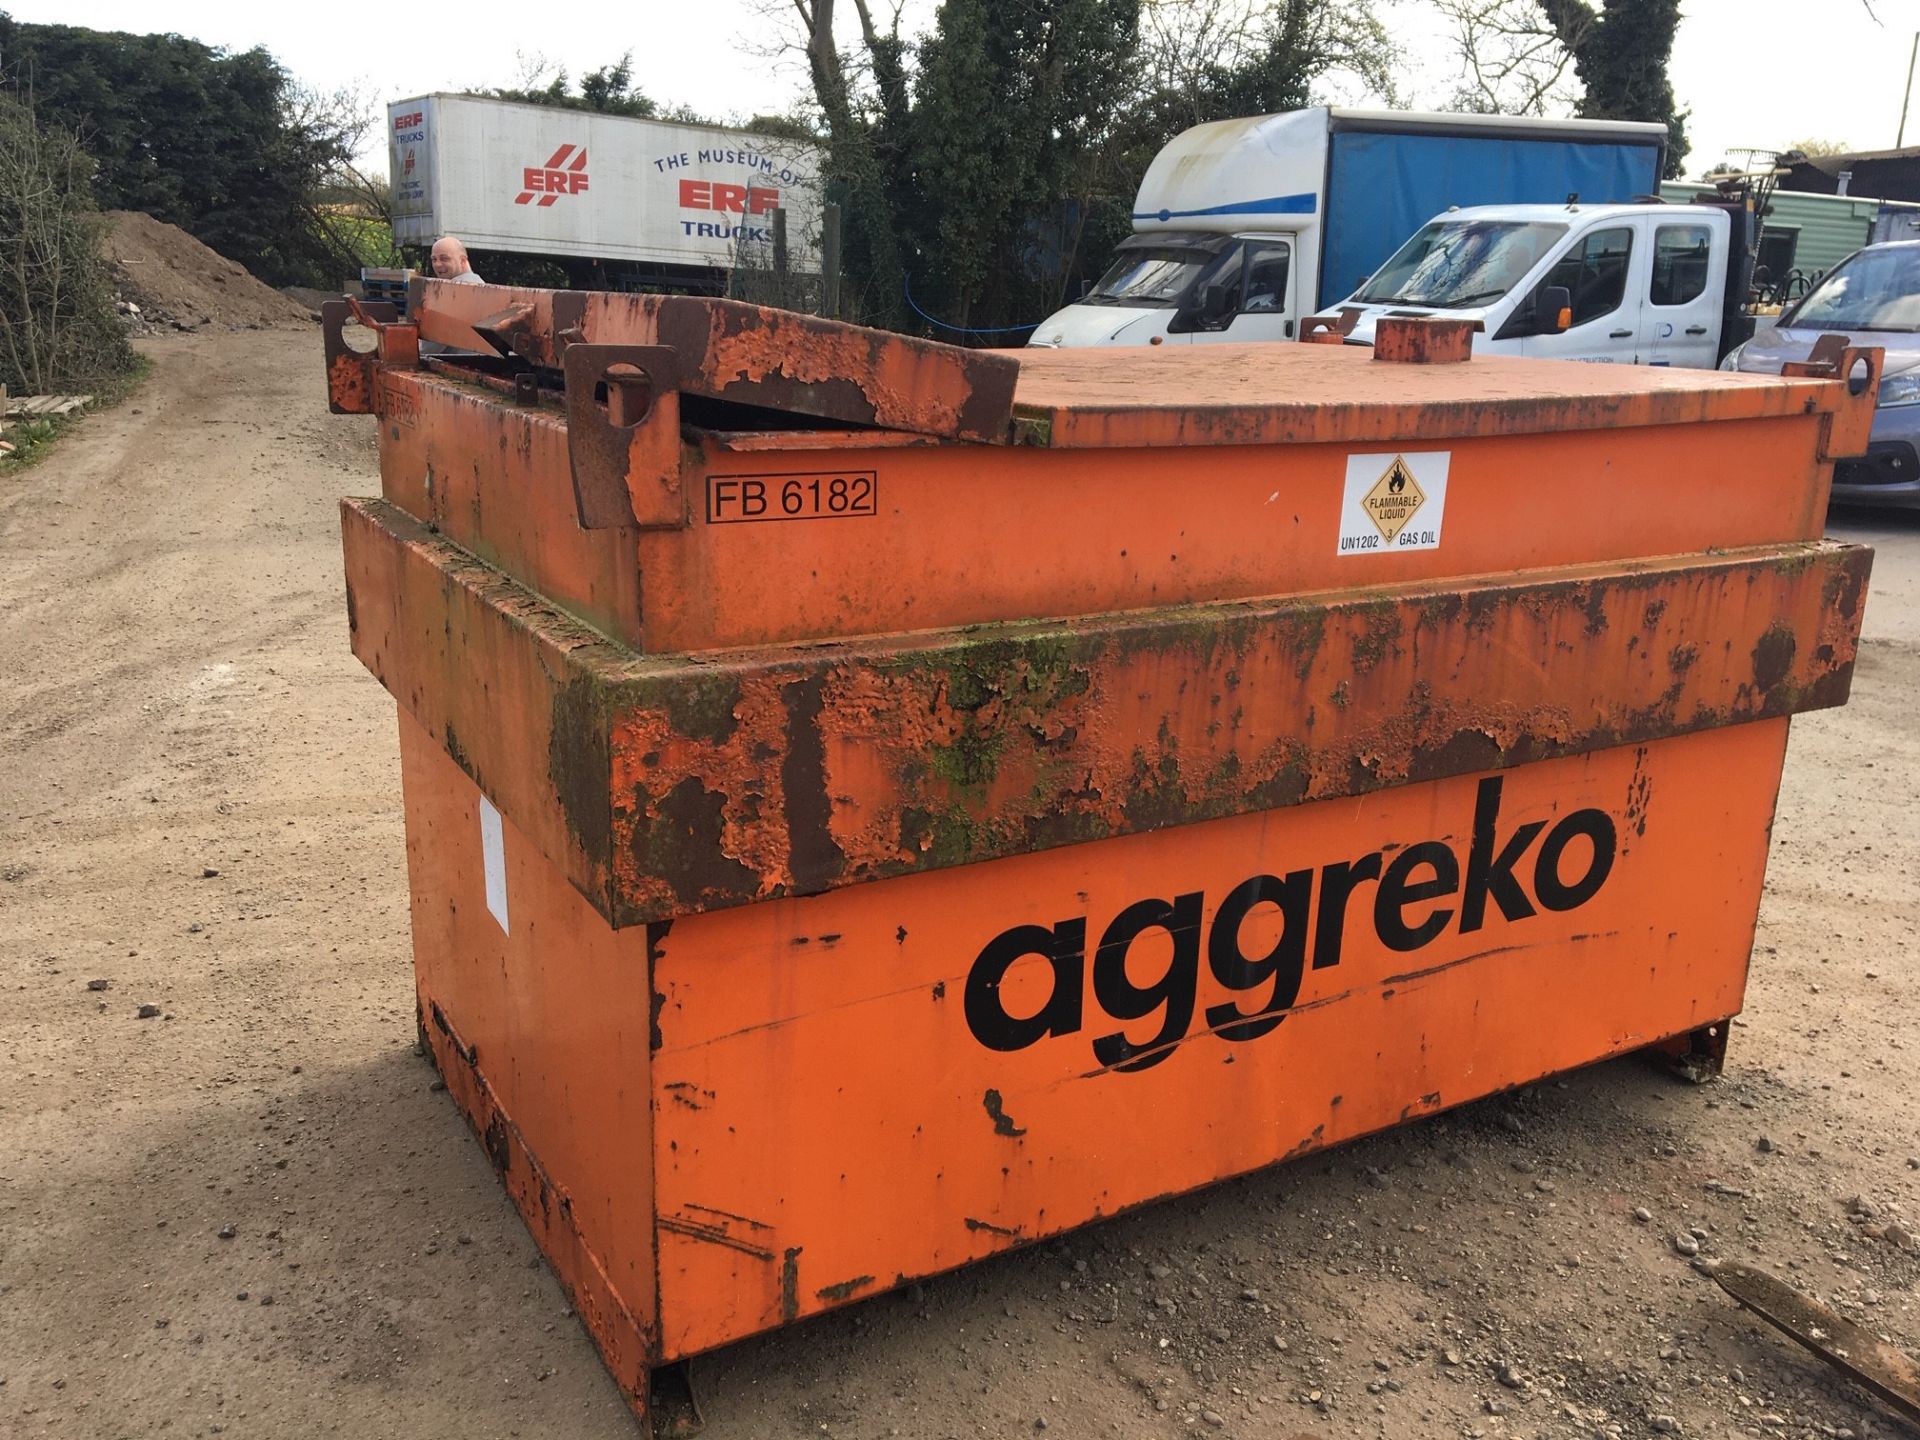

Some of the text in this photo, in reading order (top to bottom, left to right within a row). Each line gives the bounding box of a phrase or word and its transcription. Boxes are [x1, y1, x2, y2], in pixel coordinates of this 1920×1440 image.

[395, 112, 422, 129] ERF
[396, 131, 424, 144] TRUCKS
[654, 153, 690, 172] THE
[698, 149, 772, 173] MUSEUM
[524, 168, 588, 194] ERF
[679, 179, 779, 215] ERF
[715, 478, 871, 517] FB 6182
[1370, 496, 1417, 508] FLAMMABLE
[1379, 508, 1406, 519] LIQUID
[1387, 528, 1393, 539] 3
[1399, 531, 1435, 545] GAS OIL
[1341, 535, 1379, 550] UN1202
[963, 775, 1617, 1073] aggreko
